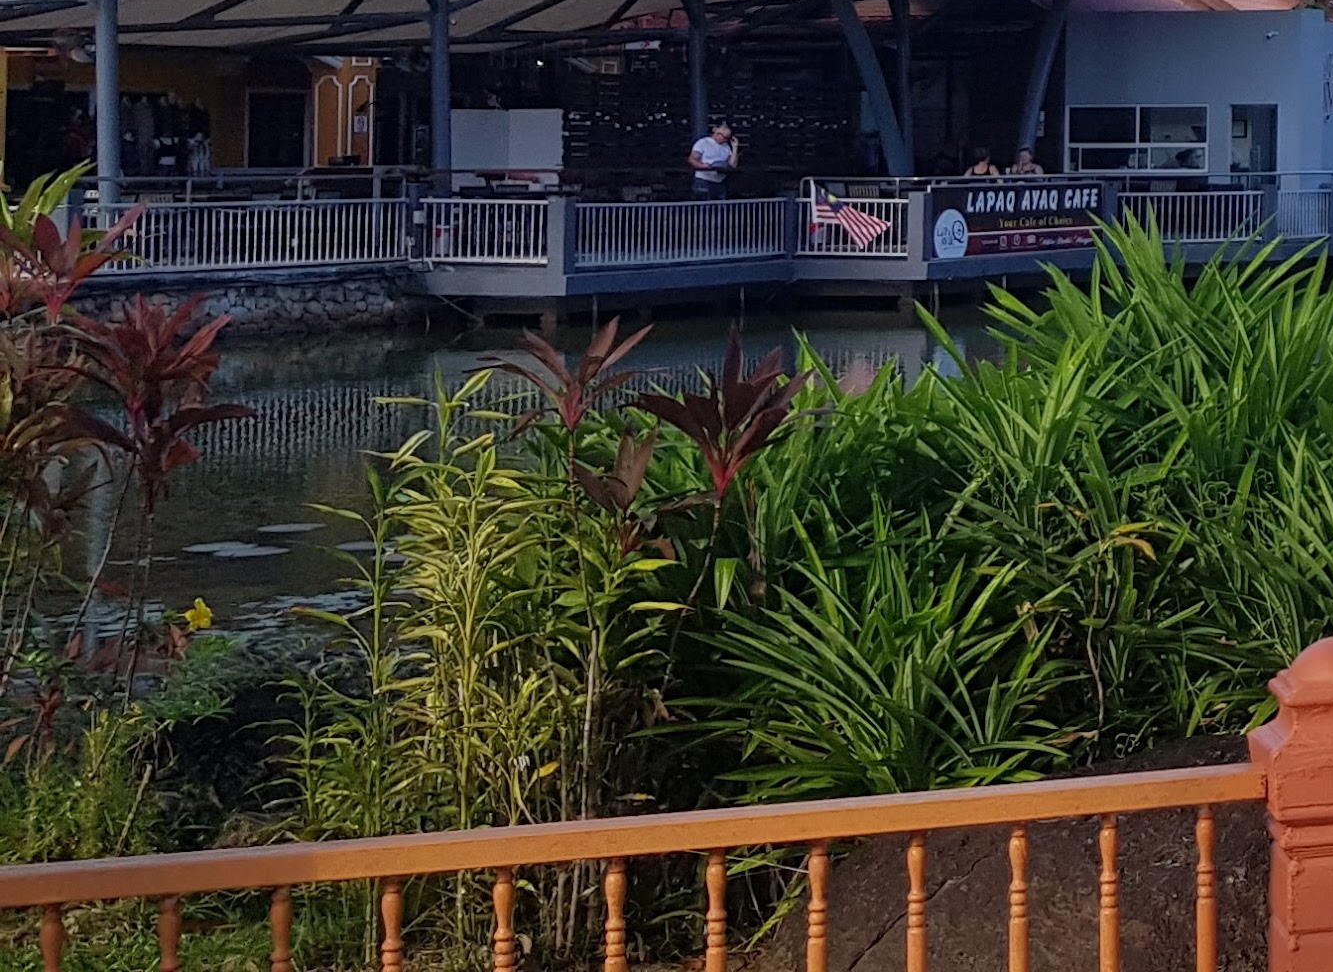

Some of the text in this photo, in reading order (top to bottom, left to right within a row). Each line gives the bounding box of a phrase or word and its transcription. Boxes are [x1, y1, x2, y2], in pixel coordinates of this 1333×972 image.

[966, 188, 1099, 213] LAPAQ AYAQ CAFE
[999, 217, 1017, 228] Your
